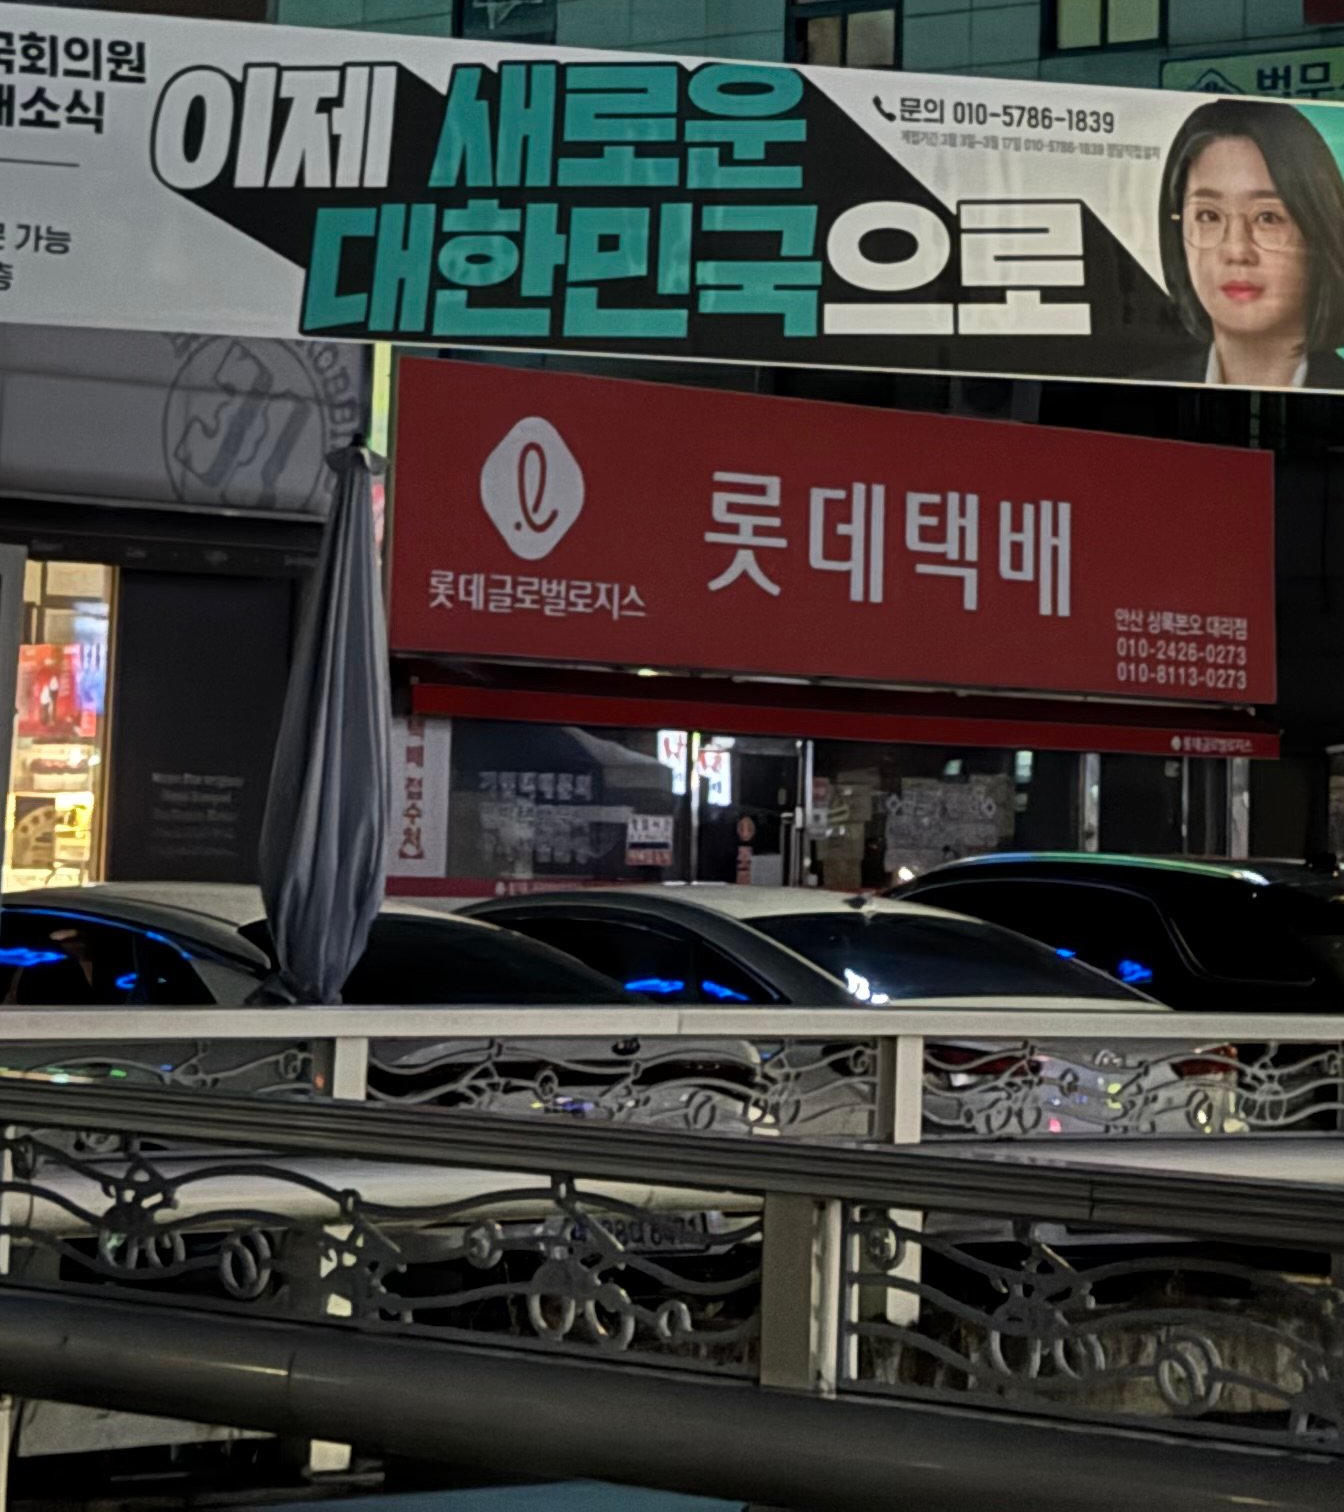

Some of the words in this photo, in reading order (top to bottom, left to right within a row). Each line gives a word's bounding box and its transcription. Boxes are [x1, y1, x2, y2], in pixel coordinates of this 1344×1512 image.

[153, 64, 397, 188] 이제
[428, 63, 806, 189] 새로운
[900, 97, 945, 125] 문의
[953, 101, 1115, 134] 010-5786-1839
[14, 225, 72, 256] 가능
[301, 198, 1092, 338] 대한민국으로
[704, 471, 1072, 617] 롯데택배
[428, 569, 646, 621] 롯데글로벌로지스
[1115, 608, 1143, 632] 안산
[1207, 616, 1248, 640] 대리점
[1117, 637, 1247, 666] 010-2426-0273
[1117, 662, 1247, 690] 010-8113-0273
